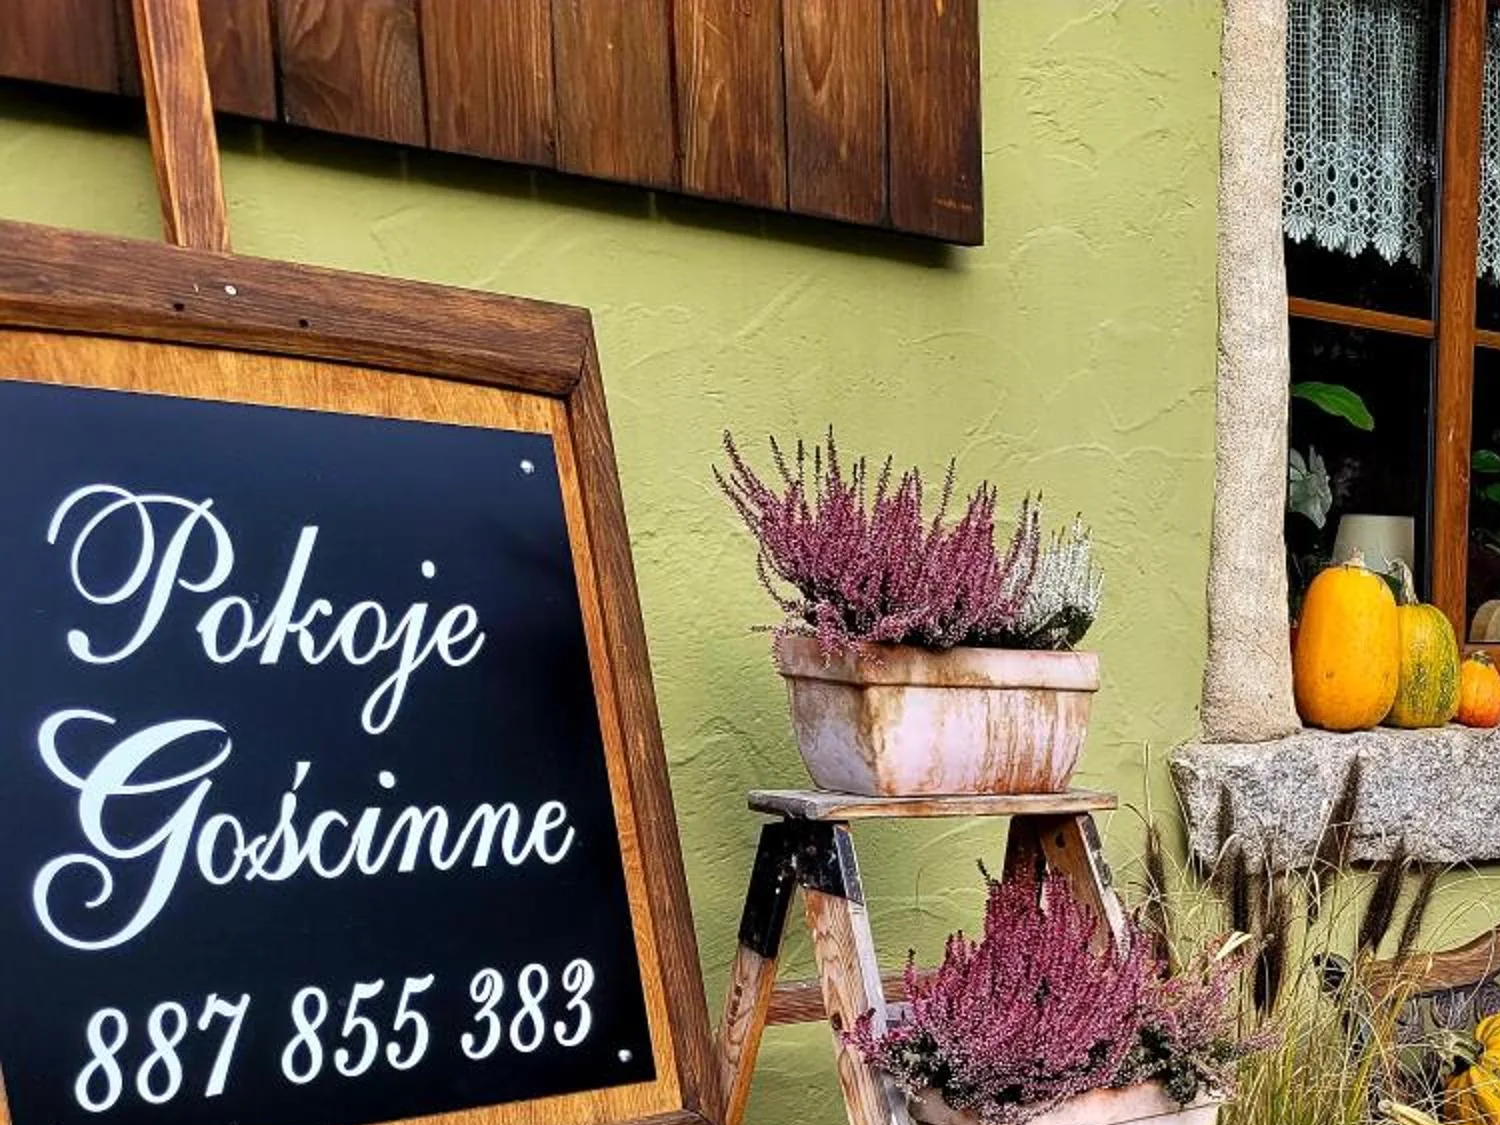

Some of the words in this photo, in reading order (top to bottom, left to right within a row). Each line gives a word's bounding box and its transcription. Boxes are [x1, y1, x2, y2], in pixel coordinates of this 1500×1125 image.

[47, 483, 485, 735] Pokoje
[33, 709, 575, 950] Gościnne
[75, 993, 251, 1113] 887
[281, 973, 435, 1084] 855
[461, 958, 595, 1060] 383
